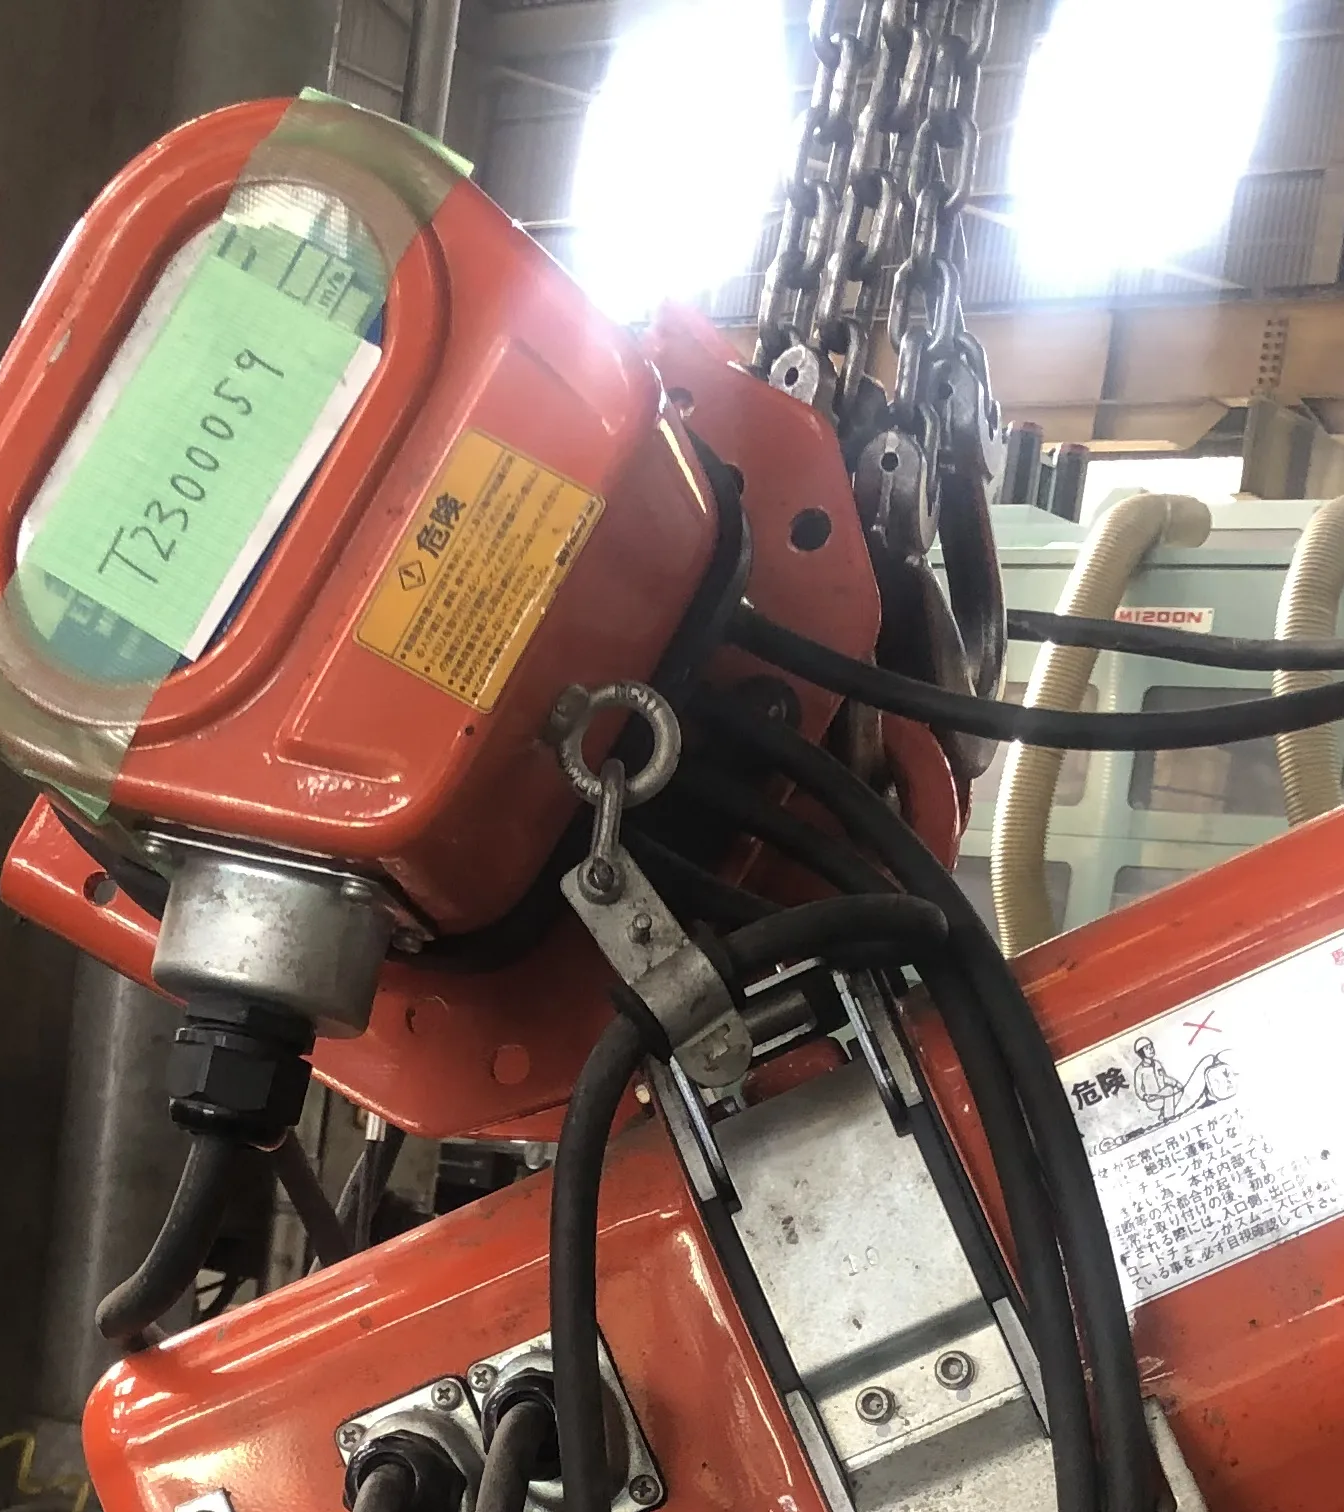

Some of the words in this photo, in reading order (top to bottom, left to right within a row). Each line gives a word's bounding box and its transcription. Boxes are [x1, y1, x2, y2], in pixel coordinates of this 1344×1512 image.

[98, 349, 286, 585] T2300059
[415, 491, 466, 560] 危険
[1070, 1064, 1130, 1112] 危険
[841, 1245, 880, 1277] 1.0
